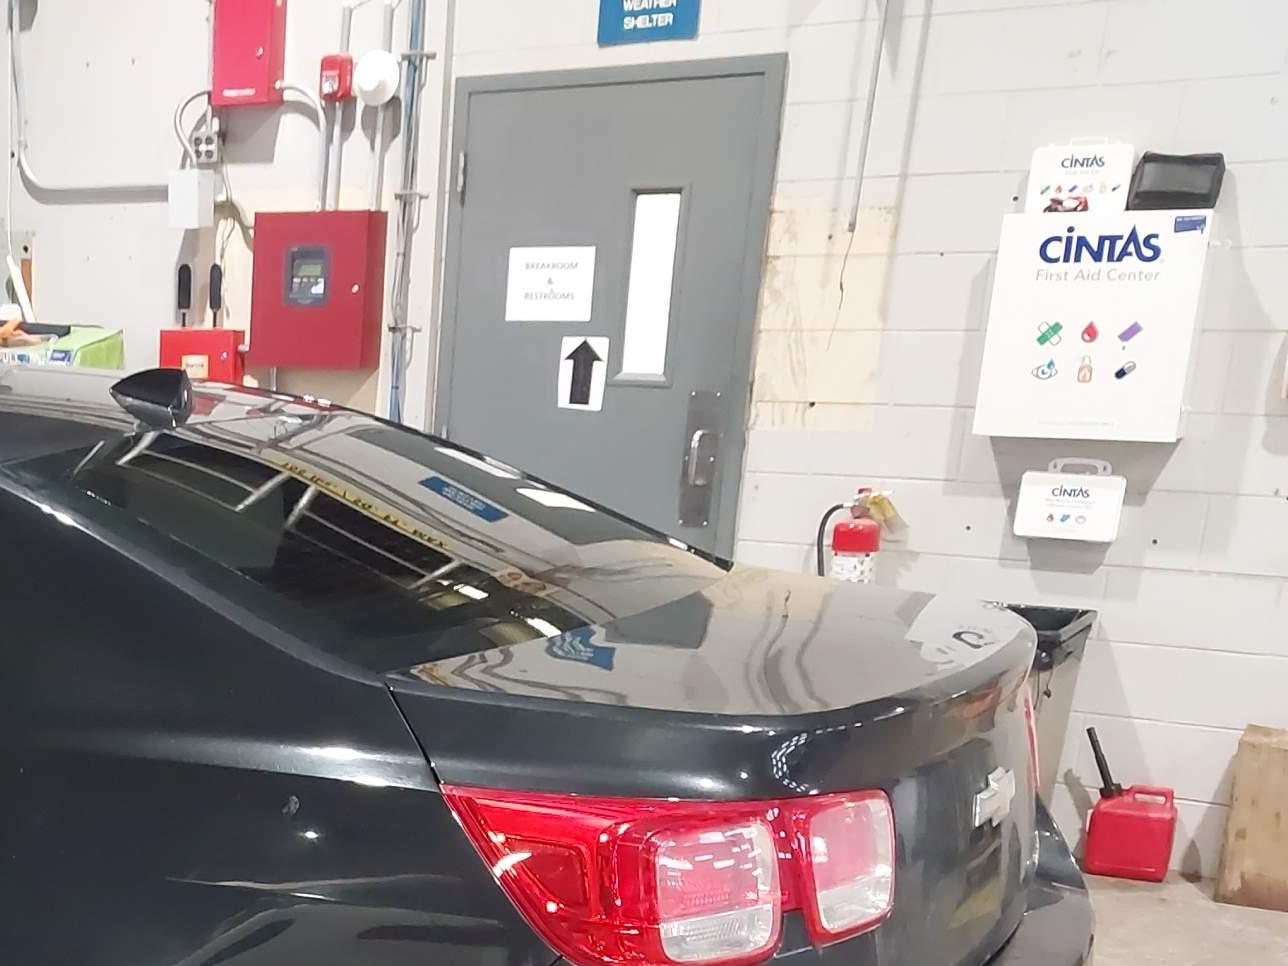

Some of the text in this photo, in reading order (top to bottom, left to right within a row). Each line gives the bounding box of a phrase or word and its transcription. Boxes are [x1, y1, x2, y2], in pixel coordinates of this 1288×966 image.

[623, 13, 674, 30] SHELTER
[525, 261, 579, 271] BREAKROOM
[1035, 268, 1160, 281] First Aid Center
[524, 292, 575, 301] RESTROOMS
